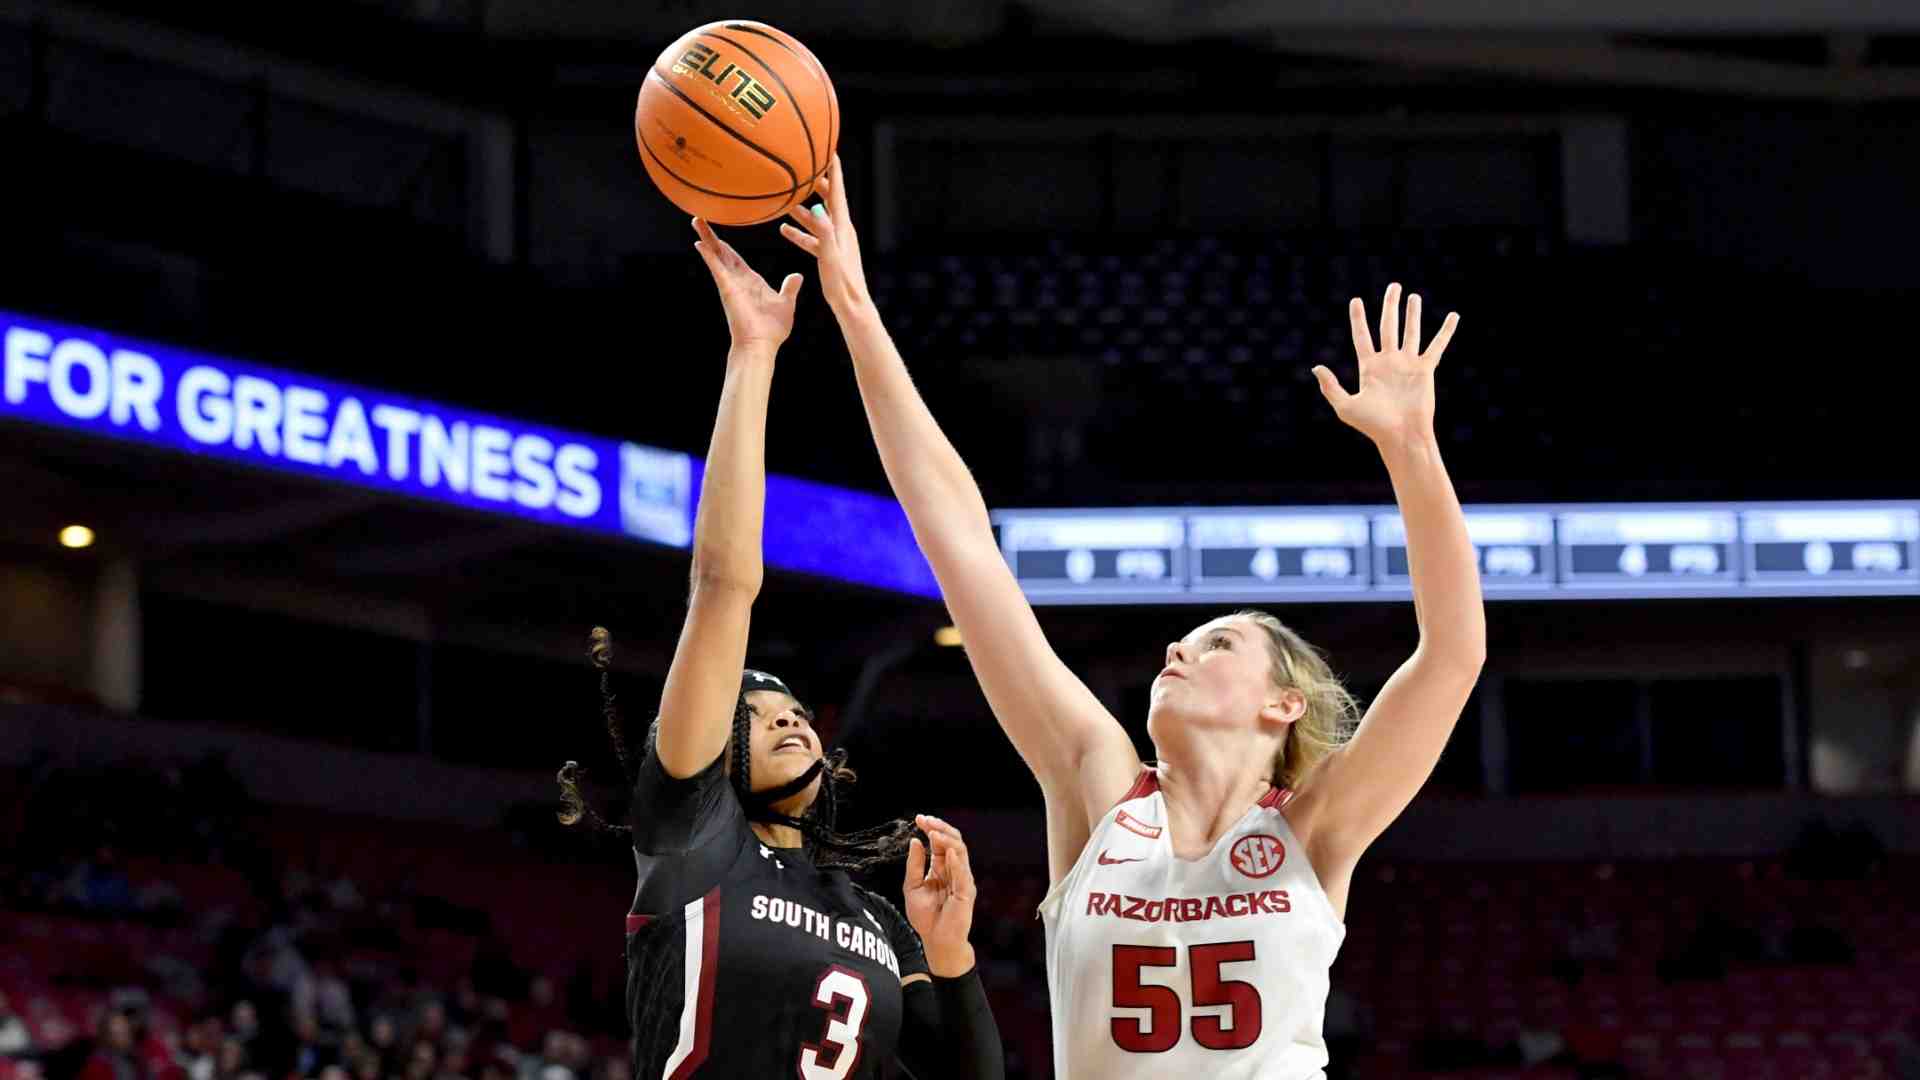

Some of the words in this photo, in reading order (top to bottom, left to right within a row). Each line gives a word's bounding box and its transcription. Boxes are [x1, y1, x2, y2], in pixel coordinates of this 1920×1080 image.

[679, 43, 777, 120] ELITE
[4, 326, 164, 432] FOR
[176, 366, 602, 518] GREATNESS
[1231, 836, 1283, 877] SEC
[751, 895, 830, 940] SOUTH
[836, 921, 901, 979] CAROLI
[1086, 890, 1291, 922] RAZORBACKS
[799, 963, 872, 1080] 3
[1110, 940, 1262, 1053] 55
